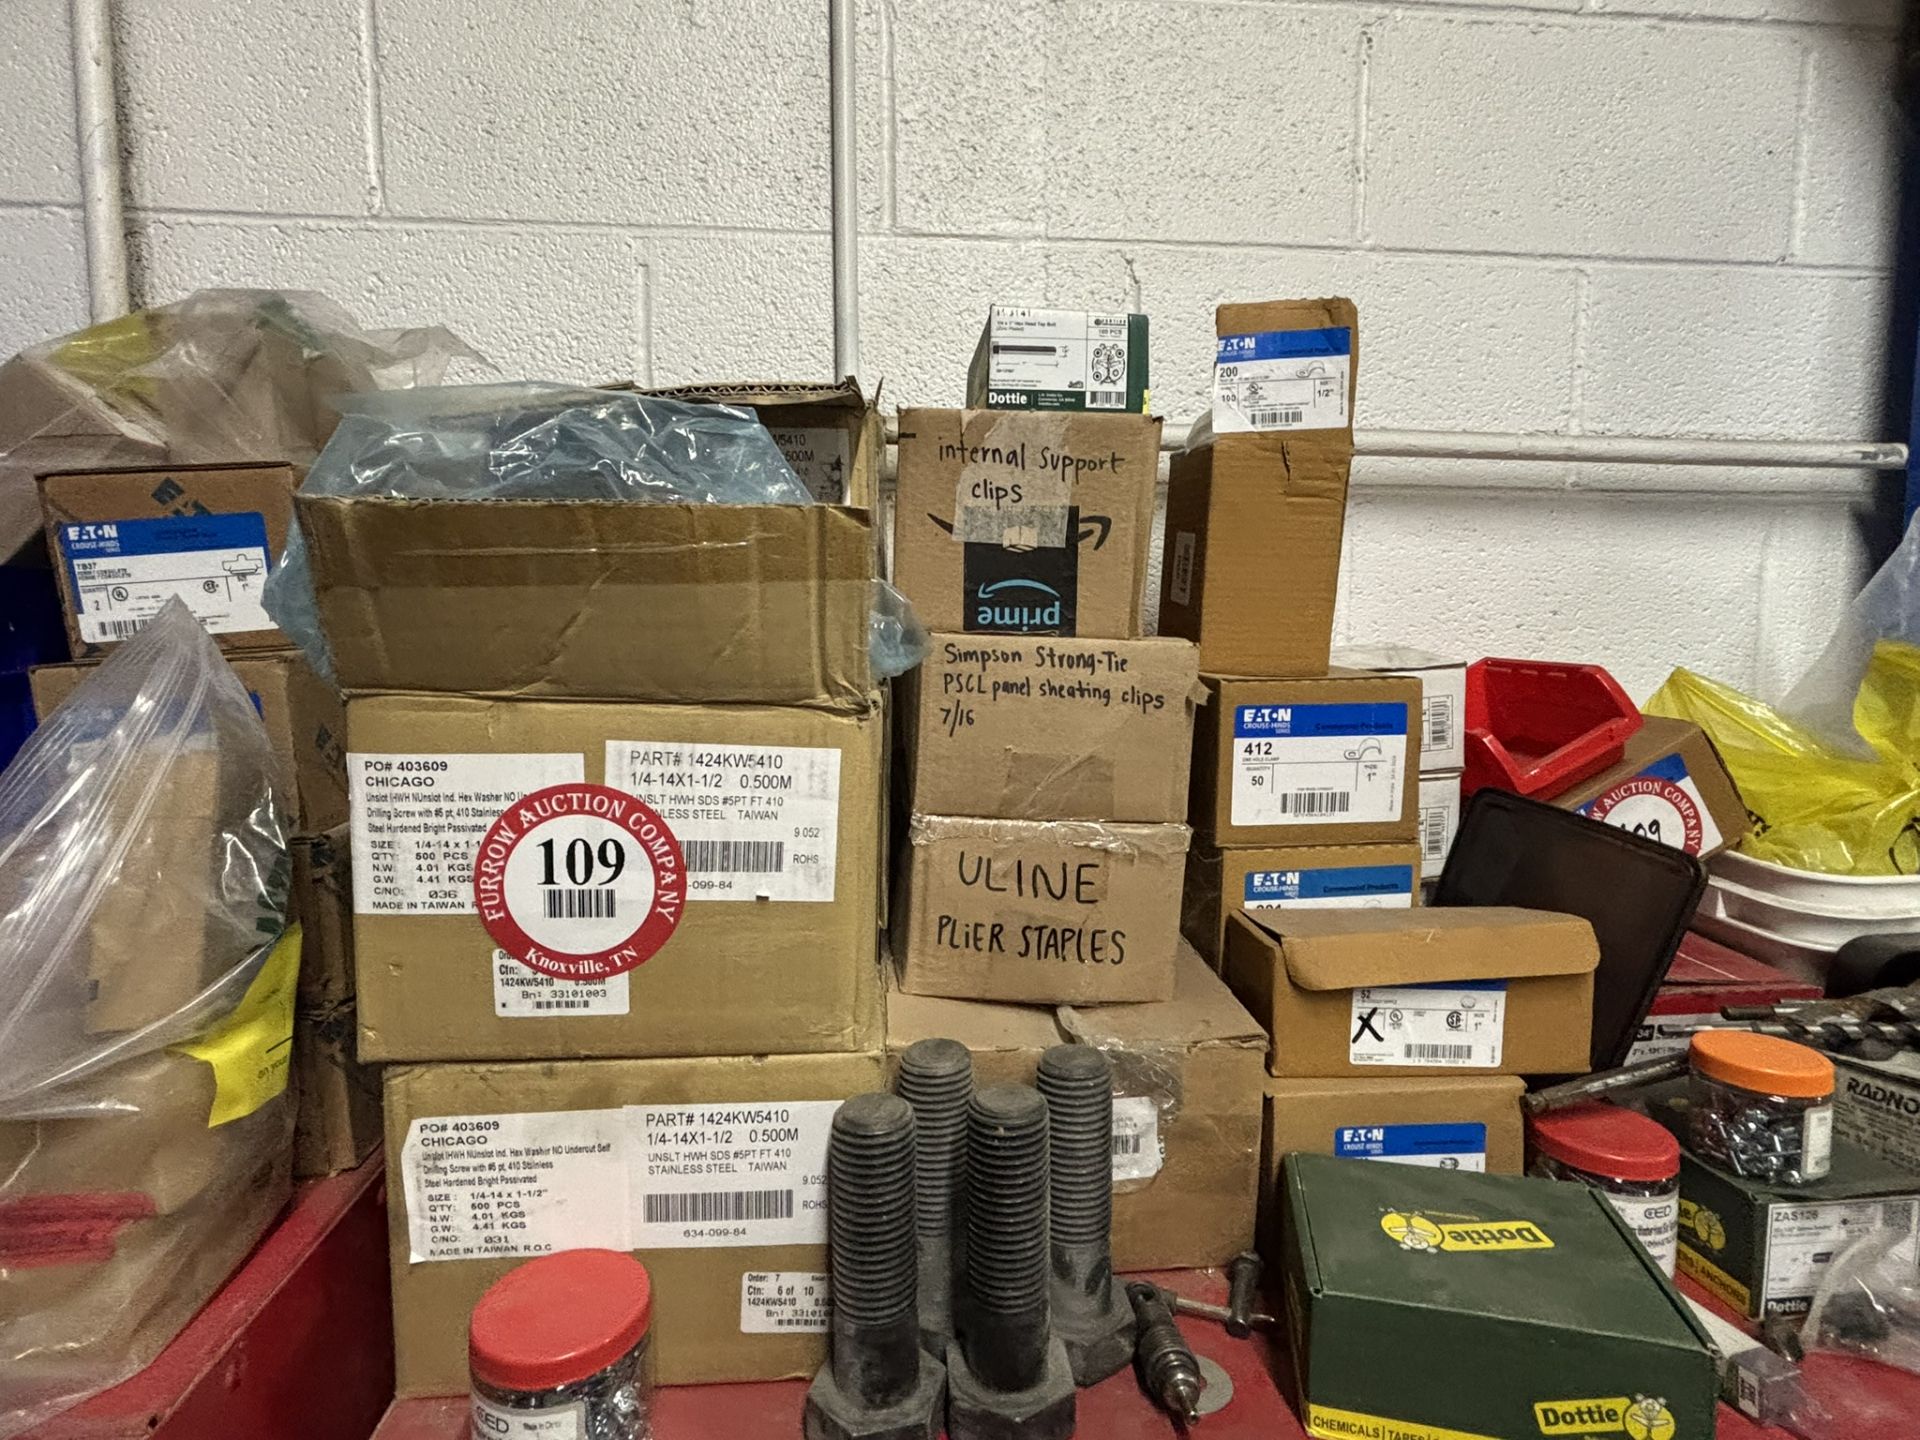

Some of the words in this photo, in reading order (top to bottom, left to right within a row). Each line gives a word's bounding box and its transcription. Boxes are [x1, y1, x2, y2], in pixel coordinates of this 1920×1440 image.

[1218, 337, 1256, 351] EATON
[1220, 366, 1238, 378] 200
[988, 392, 1028, 404] Dottie
[1317, 388, 1334, 398] 1/2"
[938, 436, 1026, 470] internal
[971, 478, 1024, 510] clips
[67, 524, 118, 541] EATON
[94, 600, 100, 612] 2
[977, 601, 1061, 631] prime
[944, 642, 1022, 672] Simpson
[944, 673, 986, 695] PSCL
[992, 676, 1031, 700] panel
[1039, 680, 1111, 706] sheating
[1121, 686, 1166, 714] clips
[940, 700, 975, 738] 7/16
[1243, 708, 1292, 722] EATON
[1244, 742, 1272, 756] 412
[364, 760, 392, 772] PO#
[397, 761, 448, 772] 403609
[630, 750, 681, 768] PART#
[688, 752, 784, 770] 1424KW5410
[366, 776, 434, 788] CHICAGO
[632, 772, 722, 788] 1/4-14X1-1/2
[740, 774, 792, 790] 0.500M
[1251, 776, 1264, 787] 50
[458, 792, 472, 802] Hex
[474, 792, 501, 803] Washer
[502, 792, 516, 803] NO
[669, 796, 695, 806] HWH
[698, 796, 720, 806] SDS
[722, 796, 746, 806] #5PT
[750, 796, 764, 806] FT
[766, 796, 784, 807] 410
[367, 808, 392, 820] Drilling
[394, 808, 416, 818] Screw
[417, 808, 433, 818] with
[456, 808, 470, 818] 410
[471, 808, 504, 819] Stainless
[692, 810, 726, 820] STEEL
[738, 810, 778, 821] TAIWAN
[1604, 781, 1662, 810] AUCTION
[1664, 786, 1700, 850] COMPANY
[368, 822, 385, 833] Steel
[387, 823, 422, 833] Hardened
[424, 822, 446, 834] Bright
[447, 822, 488, 833] Passivated
[794, 828, 820, 838] 9.052
[371, 840, 394, 849] SIZE
[416, 840, 450, 850] 1/4-14
[415, 853, 436, 862] 500
[443, 852, 468, 862] PCS
[480, 820, 519, 922] FURROW
[518, 792, 627, 829] AUCTION
[628, 812, 680, 924] COMPANY
[536, 838, 626, 886] 109
[793, 854, 820, 864] ROHS
[416, 864, 440, 873] 4.01
[448, 864, 474, 872] KGS
[416, 876, 441, 884] 4.41
[448, 876, 474, 884] KGS
[958, 851, 1101, 904] ULINE
[1253, 872, 1300, 886] EATON
[374, 886, 404, 896] C/NO:
[428, 890, 458, 900] 036
[372, 902, 404, 910] MADE
[407, 902, 418, 910] IN
[420, 902, 465, 910] TAIWAN
[1018, 924, 1126, 966] STAPLES
[524, 946, 610, 974] Knoxville,
[610, 946, 638, 968] TN
[499, 964, 518, 976] Ctn:
[500, 978, 554, 987] 1424KW5410
[550, 990, 607, 998] 33101003
[1360, 990, 1370, 998] 52
[1847, 1076, 1920, 1114] RADNO
[646, 1112, 696, 1128] PART#
[700, 1110, 790, 1125] 1424KW5410
[420, 1123, 448, 1134] PO#
[452, 1120, 500, 1132] 403609
[421, 1134, 488, 1148] CHICAGO
[647, 1130, 733, 1146] 1/4-14X1-1/2
[750, 1128, 799, 1144] 0.500M
[1343, 1128, 1384, 1143] EATON
[510, 1148, 524, 1158] Hex
[564, 1144, 596, 1155] Undercut
[648, 1152, 680, 1162] UNSLT
[683, 1152, 708, 1162] HWH
[710, 1151, 730, 1160] SDS
[732, 1150, 757, 1160] #5PT
[760, 1149, 772, 1158] FT
[774, 1148, 792, 1158] 410
[449, 1164, 471, 1174] Screw
[472, 1162, 486, 1173] with
[508, 1160, 520, 1172] 410
[522, 1160, 554, 1170] Stainless
[648, 1164, 704, 1176] STAINLESS
[706, 1163, 738, 1174] STEEL
[748, 1162, 788, 1172] TAIWAN
[424, 1178, 442, 1189] Steel
[443, 1177, 476, 1188] Hardened
[477, 1176, 499, 1188] Bright
[500, 1174, 537, 1186] Passivated
[802, 1175, 827, 1186] 9.052
[470, 1190, 504, 1200] 1/4-14
[517, 1188, 549, 1198] 1-1/2"
[428, 1204, 456, 1214] Q'TY:
[471, 1202, 490, 1210] 500
[497, 1200, 520, 1210] PCS
[802, 1200, 828, 1210] ROHS
[472, 1212, 494, 1221] 4.01
[501, 1210, 526, 1219] KGS
[472, 1222, 495, 1230] 4.41
[502, 1221, 526, 1230] KGS
[484, 1236, 510, 1244] 031
[683, 1228, 747, 1238] 634-099-84
[1446, 1226, 1544, 1246] Dottie
[430, 1247, 460, 1256] MADE
[464, 1246, 474, 1254] IN
[477, 1245, 518, 1254] TAIWAN
[748, 1285, 764, 1296] Ctn:
[786, 1286, 794, 1296] of
[804, 1286, 814, 1296] 10
[748, 1298, 796, 1307] 1424KW5410
[1540, 1405, 1620, 1427] Dottie
[1312, 1415, 1380, 1439] CHEMICALS
